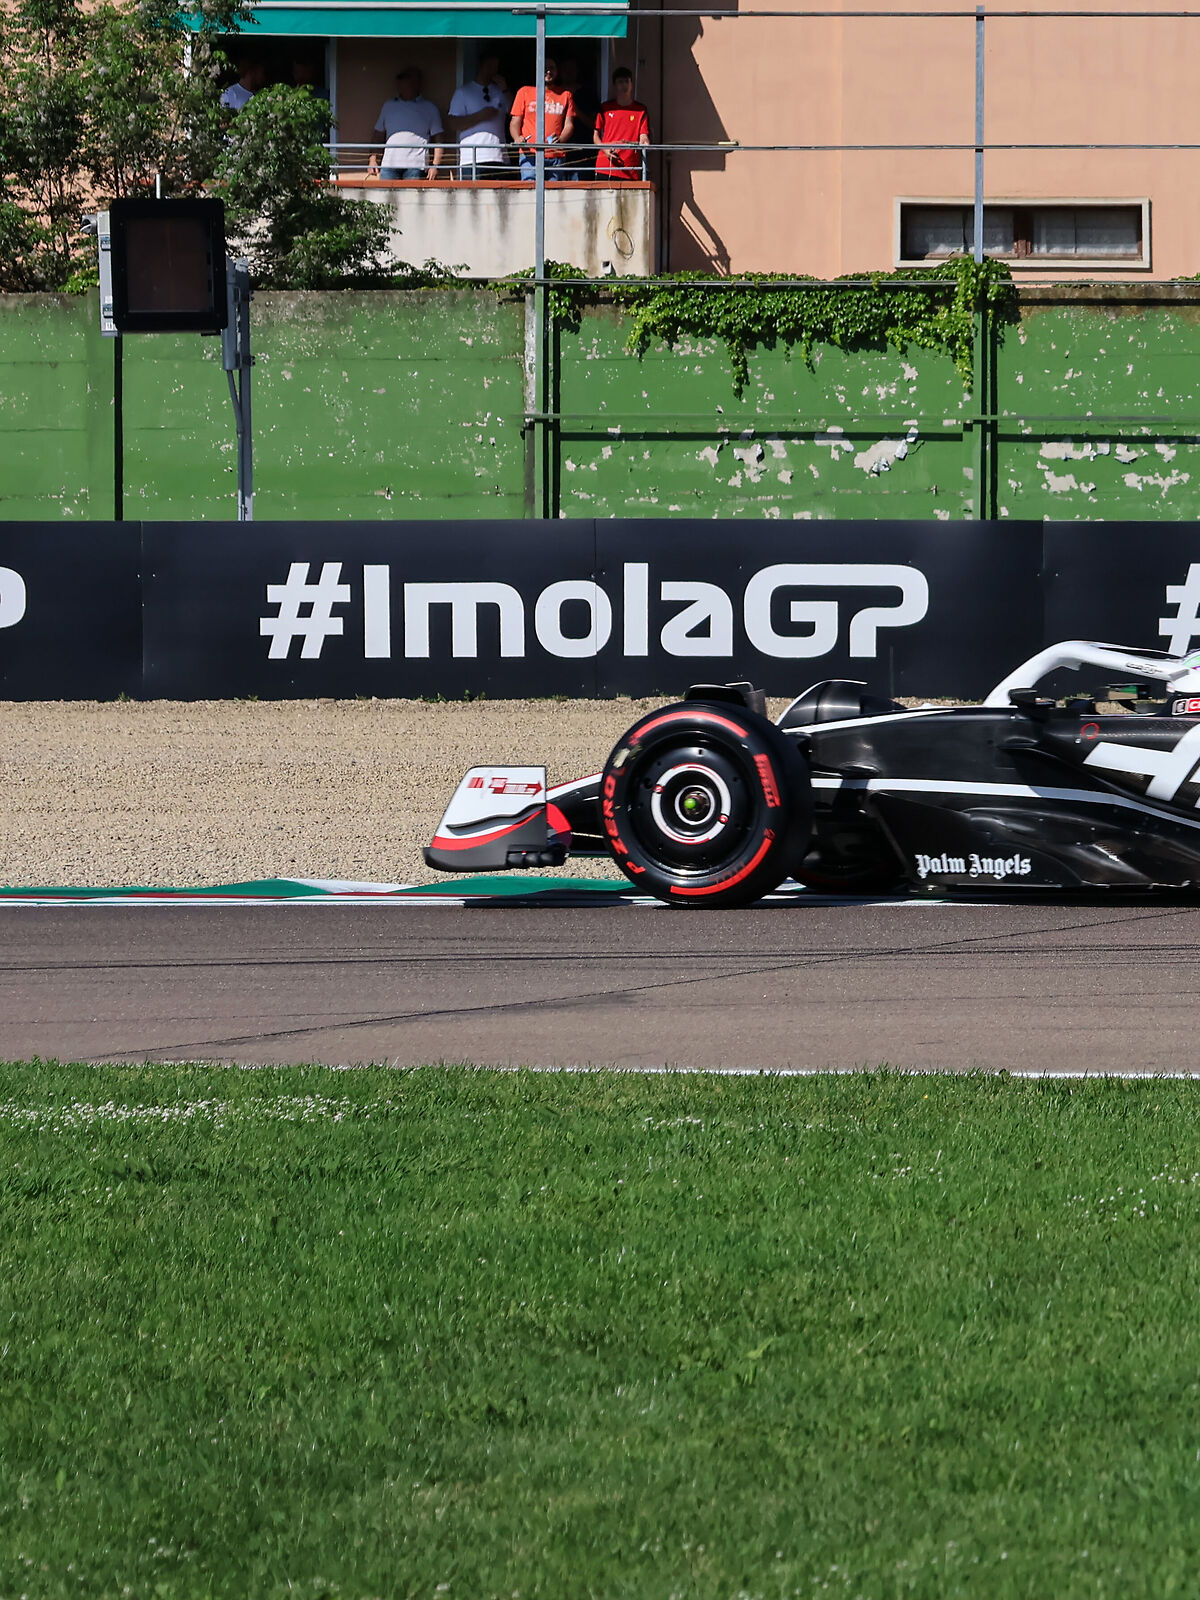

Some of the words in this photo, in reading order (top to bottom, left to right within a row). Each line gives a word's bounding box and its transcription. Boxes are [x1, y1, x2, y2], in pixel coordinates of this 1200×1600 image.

[260, 562, 929, 659] #ImolaGP
[602, 774, 629, 855] ZERO
[914, 853, 967, 879] Palm
[968, 853, 1031, 880] Angels
